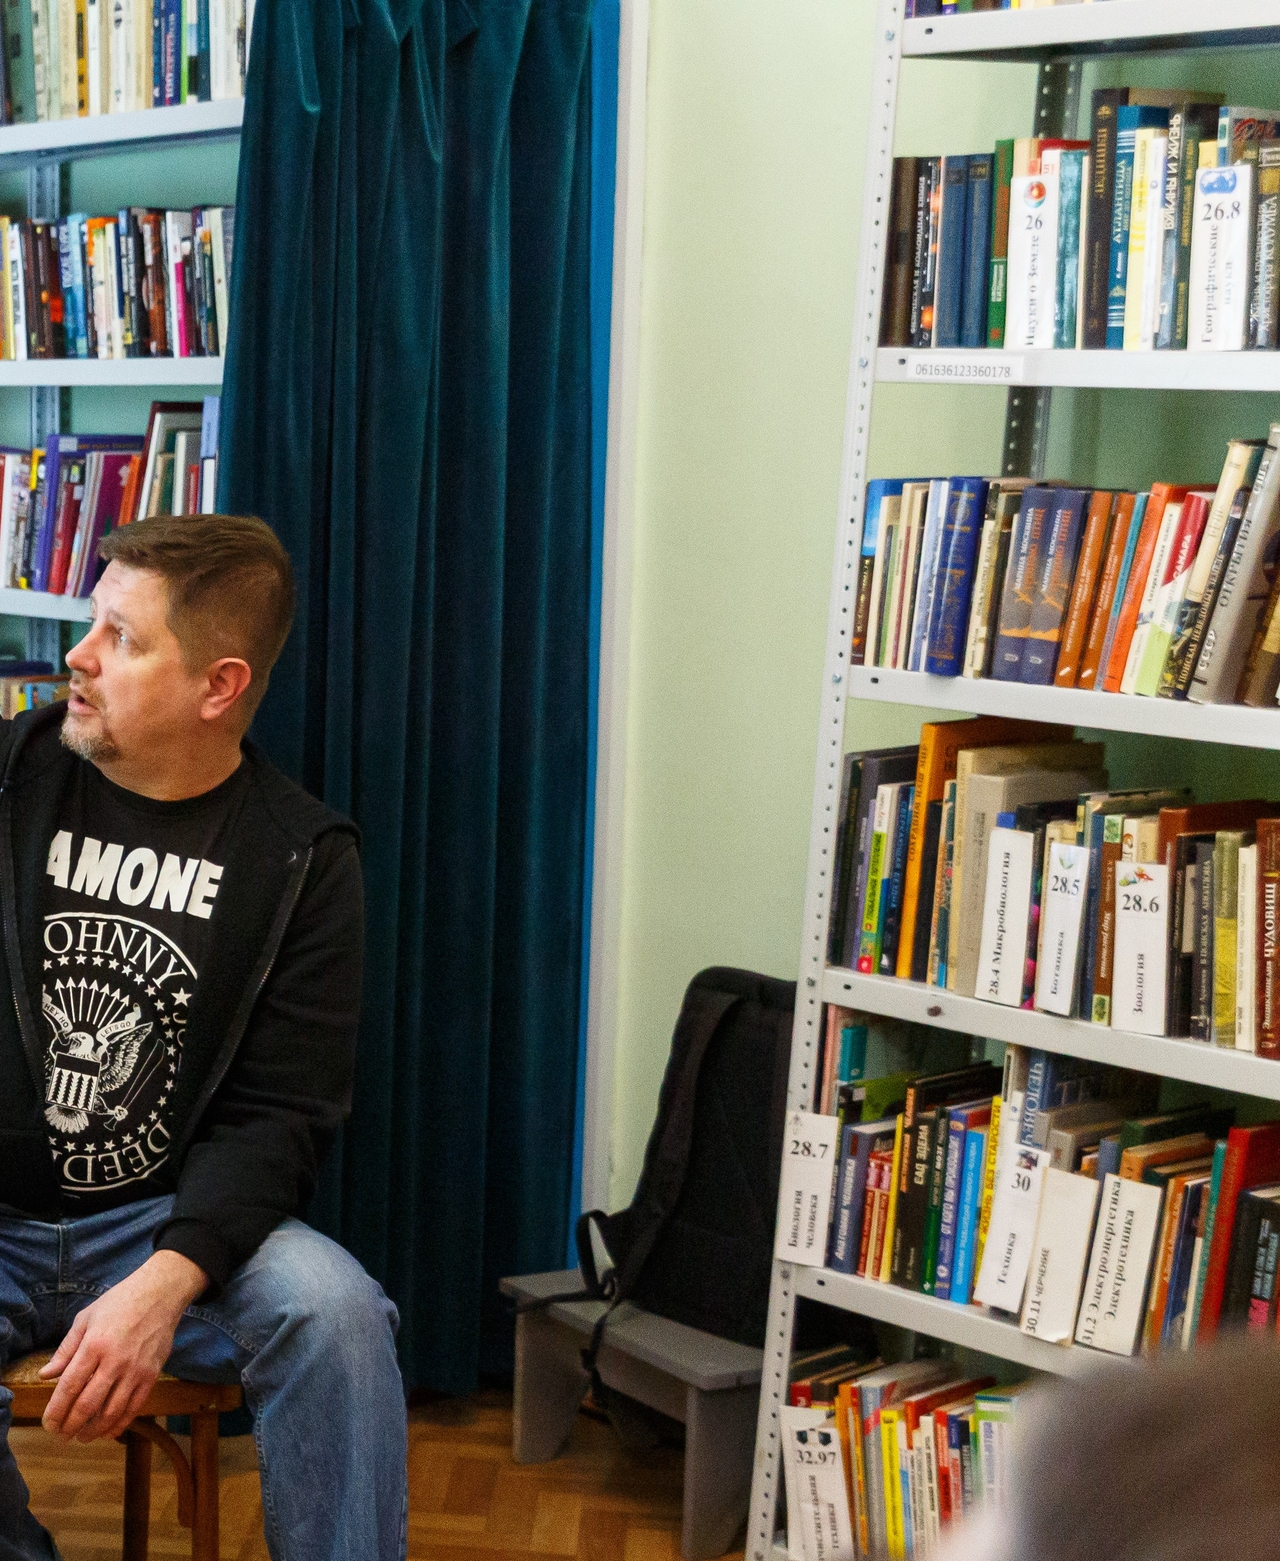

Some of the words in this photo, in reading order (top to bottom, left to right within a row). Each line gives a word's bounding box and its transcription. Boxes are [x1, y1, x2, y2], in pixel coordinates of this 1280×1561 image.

[1167, 113, 1182, 159] ЖИЗНЬ
[1167, 163, 1178, 174] И
[1024, 213, 1043, 231] 26
[1112, 159, 1126, 243] АТЛАНТИДА
[1163, 177, 1178, 230] ВУЛКАНЫ
[1201, 202, 1241, 222] 26.8
[1028, 235, 1040, 280] Земле
[1028, 285, 1037, 293] о
[1200, 224, 1218, 343] Географические
[1223, 261, 1234, 305] науки
[1024, 298, 1040, 346] Науки
[915, 364, 1011, 378] 061636123360178
[1019, 507, 1035, 554] МОСКВИНА
[1040, 557, 1054, 592] МАРИНА
[1047, 508, 1063, 556] МОСКВИНА
[1013, 554, 1027, 590] МАРИНА
[1144, 544, 1168, 605] Антарктическая
[1173, 533, 1192, 579] САМАРА
[1197, 628, 1219, 672] СССР
[1217, 518, 1254, 609] ОТКРЫТИЯ
[1252, 457, 1272, 496] США
[1178, 642, 1198, 684] ПОИСКАХ
[1190, 586, 1215, 642] НЕВЕДОМЫХ
[1208, 552, 1225, 587] ЗЕМЕЛЬ
[907, 800, 921, 862] СОХРАНИМ
[919, 744, 929, 769] МИР
[46, 829, 224, 920] AMONE
[1051, 875, 1080, 895] 28.5
[991, 851, 1013, 965] Микробиология
[1102, 912, 1113, 933] Мир
[1121, 893, 1160, 914] 28.6
[1263, 883, 1276, 958] ЧУДОВИЩ
[43, 919, 188, 989] OHNNY
[1200, 914, 1210, 958] ПОИСКАХ
[988, 968, 1001, 996] 28.4
[1049, 931, 1065, 996] Ботаника
[1131, 953, 1145, 1015] Зоология
[43, 1003, 58, 1017] HEY
[59, 1016, 70, 1029] HO
[1262, 960, 1273, 1030] Энциклопедия
[100, 1025, 119, 1038] LET'S
[119, 1021, 131, 1029] GO
[790, 1139, 828, 1159] 28.7
[915, 1124, 929, 1161] ЭДЕМА
[987, 1104, 1001, 1166] СТАРОСТИ
[841, 1158, 856, 1207] человека
[913, 1162, 926, 1185] САД
[984, 1169, 995, 1190] БЕЗ
[1010, 1173, 1031, 1192] 30
[787, 1190, 803, 1247] Биология
[806, 1194, 818, 1249] человека
[834, 1208, 850, 1260] Анатомия
[980, 1194, 992, 1236] ЖИЗНЬ
[995, 1231, 1018, 1286] Техника
[1103, 1209, 1136, 1322] Электротехника
[1024, 1298, 1042, 1335] 30.11
[1033, 1247, 1051, 1298] ЧЕРЧЕНИЕ
[1082, 1316, 1097, 1345] 31.2
[795, 1451, 836, 1466] 32.97
